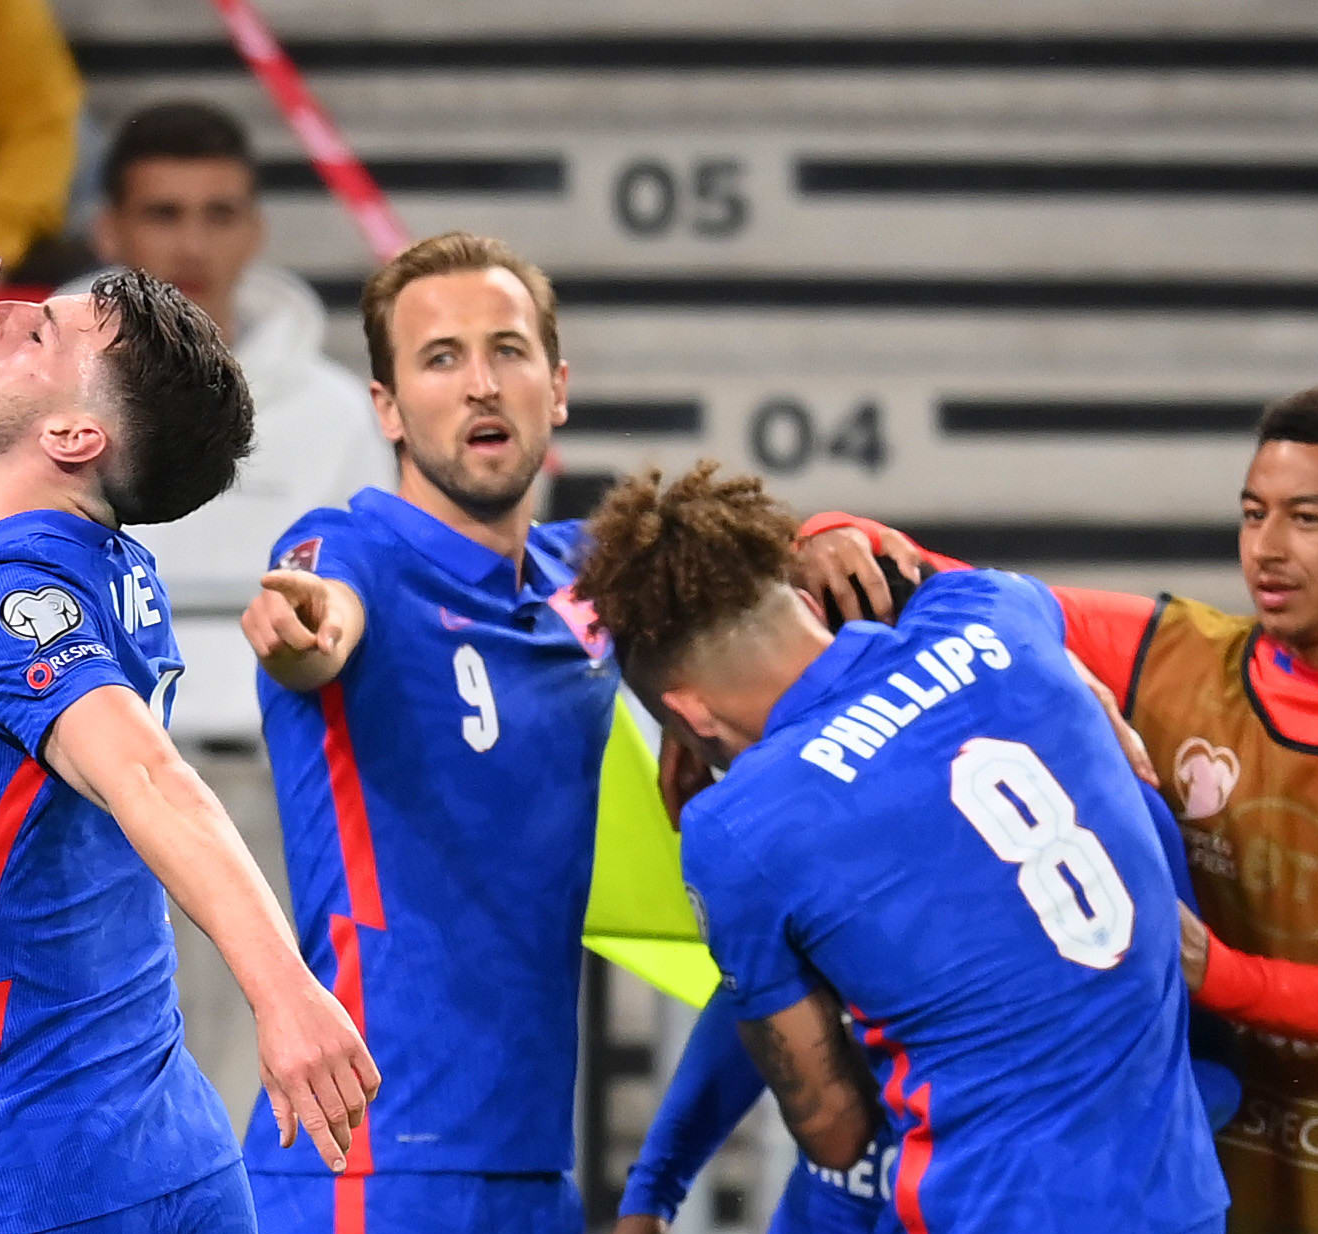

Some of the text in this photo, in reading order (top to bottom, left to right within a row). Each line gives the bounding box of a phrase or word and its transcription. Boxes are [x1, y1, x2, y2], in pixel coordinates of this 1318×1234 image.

[614, 160, 748, 239] 05
[749, 400, 885, 475] 04
[49, 643, 114, 670] RESPECT
[453, 643, 499, 753] 9
[799, 623, 1012, 783] PHILLIPS
[949, 736, 1135, 970] 8
